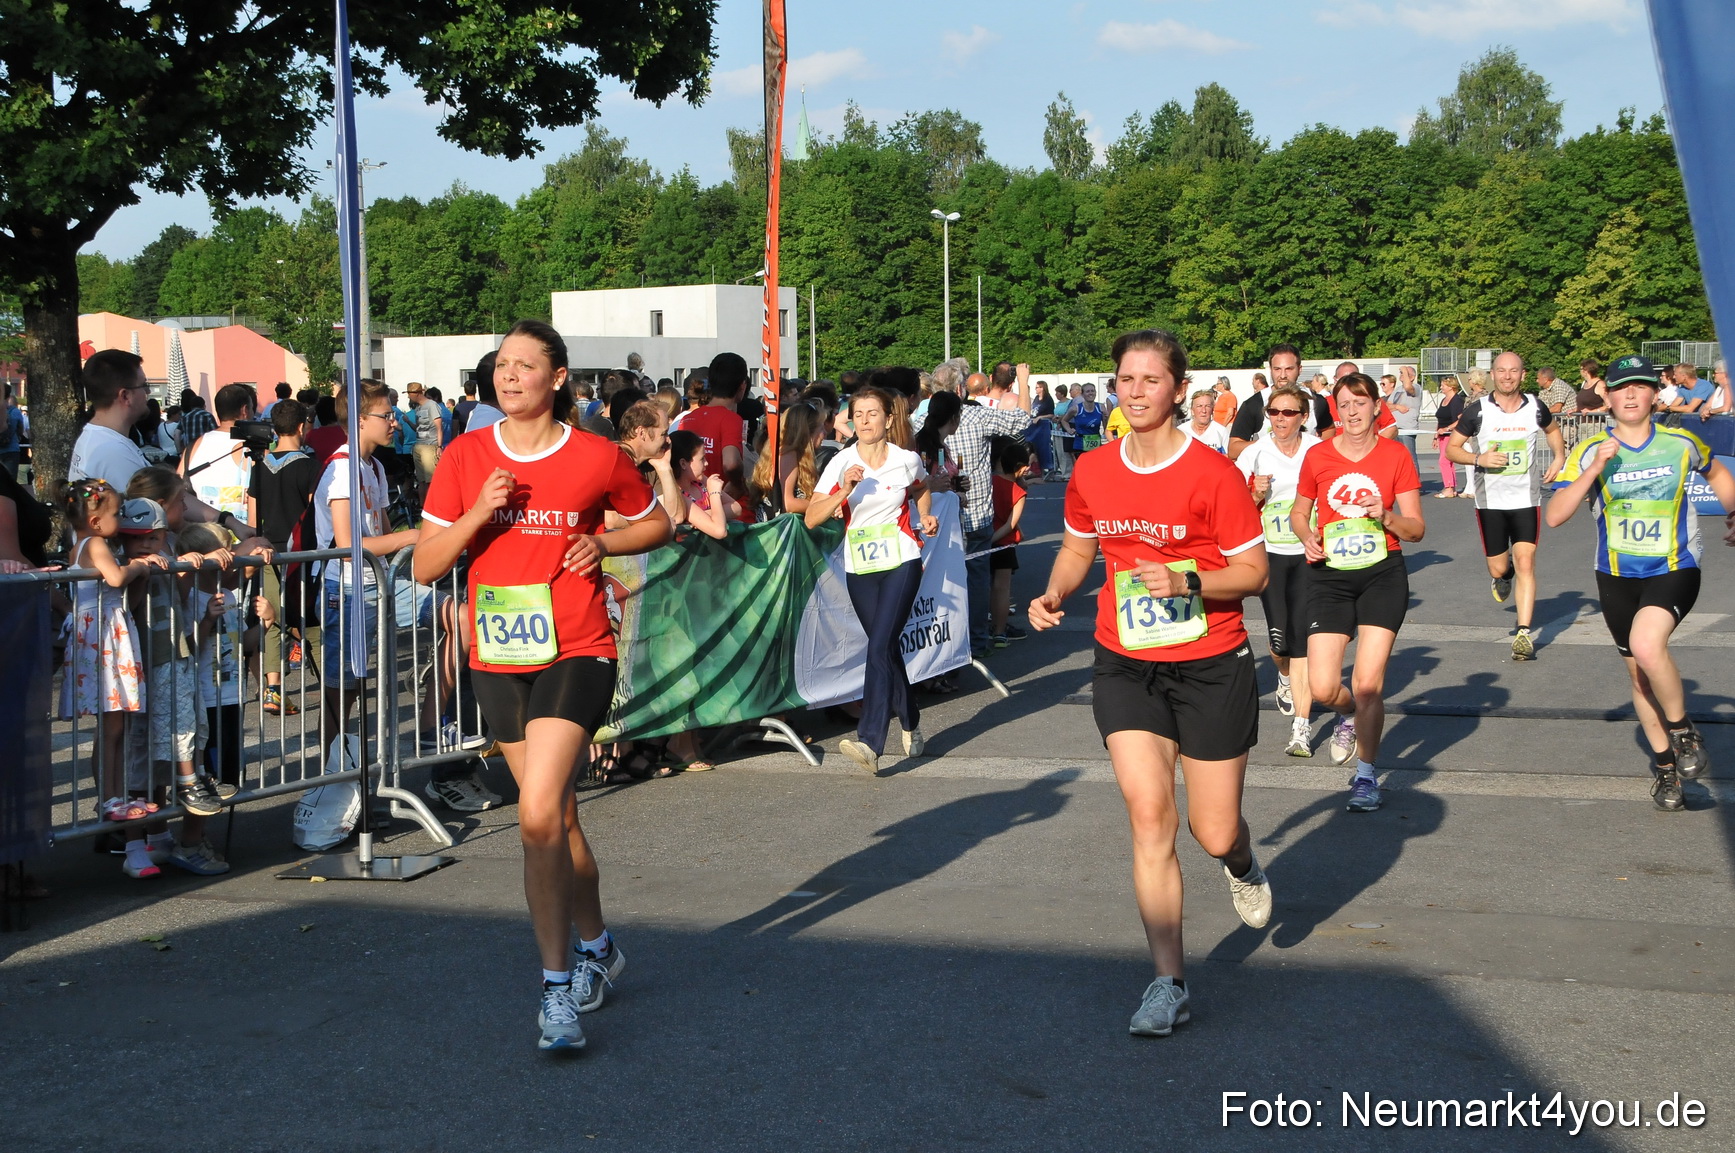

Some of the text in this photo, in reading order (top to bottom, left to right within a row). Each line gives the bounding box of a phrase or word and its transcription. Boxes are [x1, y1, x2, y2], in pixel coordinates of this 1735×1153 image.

[1506, 452, 1522, 466] 15
[1612, 465, 1674, 484] BOCK
[489, 509, 563, 526] UMARKT
[1272, 516, 1293, 532] 11
[1093, 519, 1168, 539] NEUMARKT
[1618, 519, 1661, 541] 104
[857, 540, 889, 561] 121
[1333, 535, 1376, 557] 455
[1120, 595, 1195, 629] 1337
[477, 613, 550, 645] 1340
